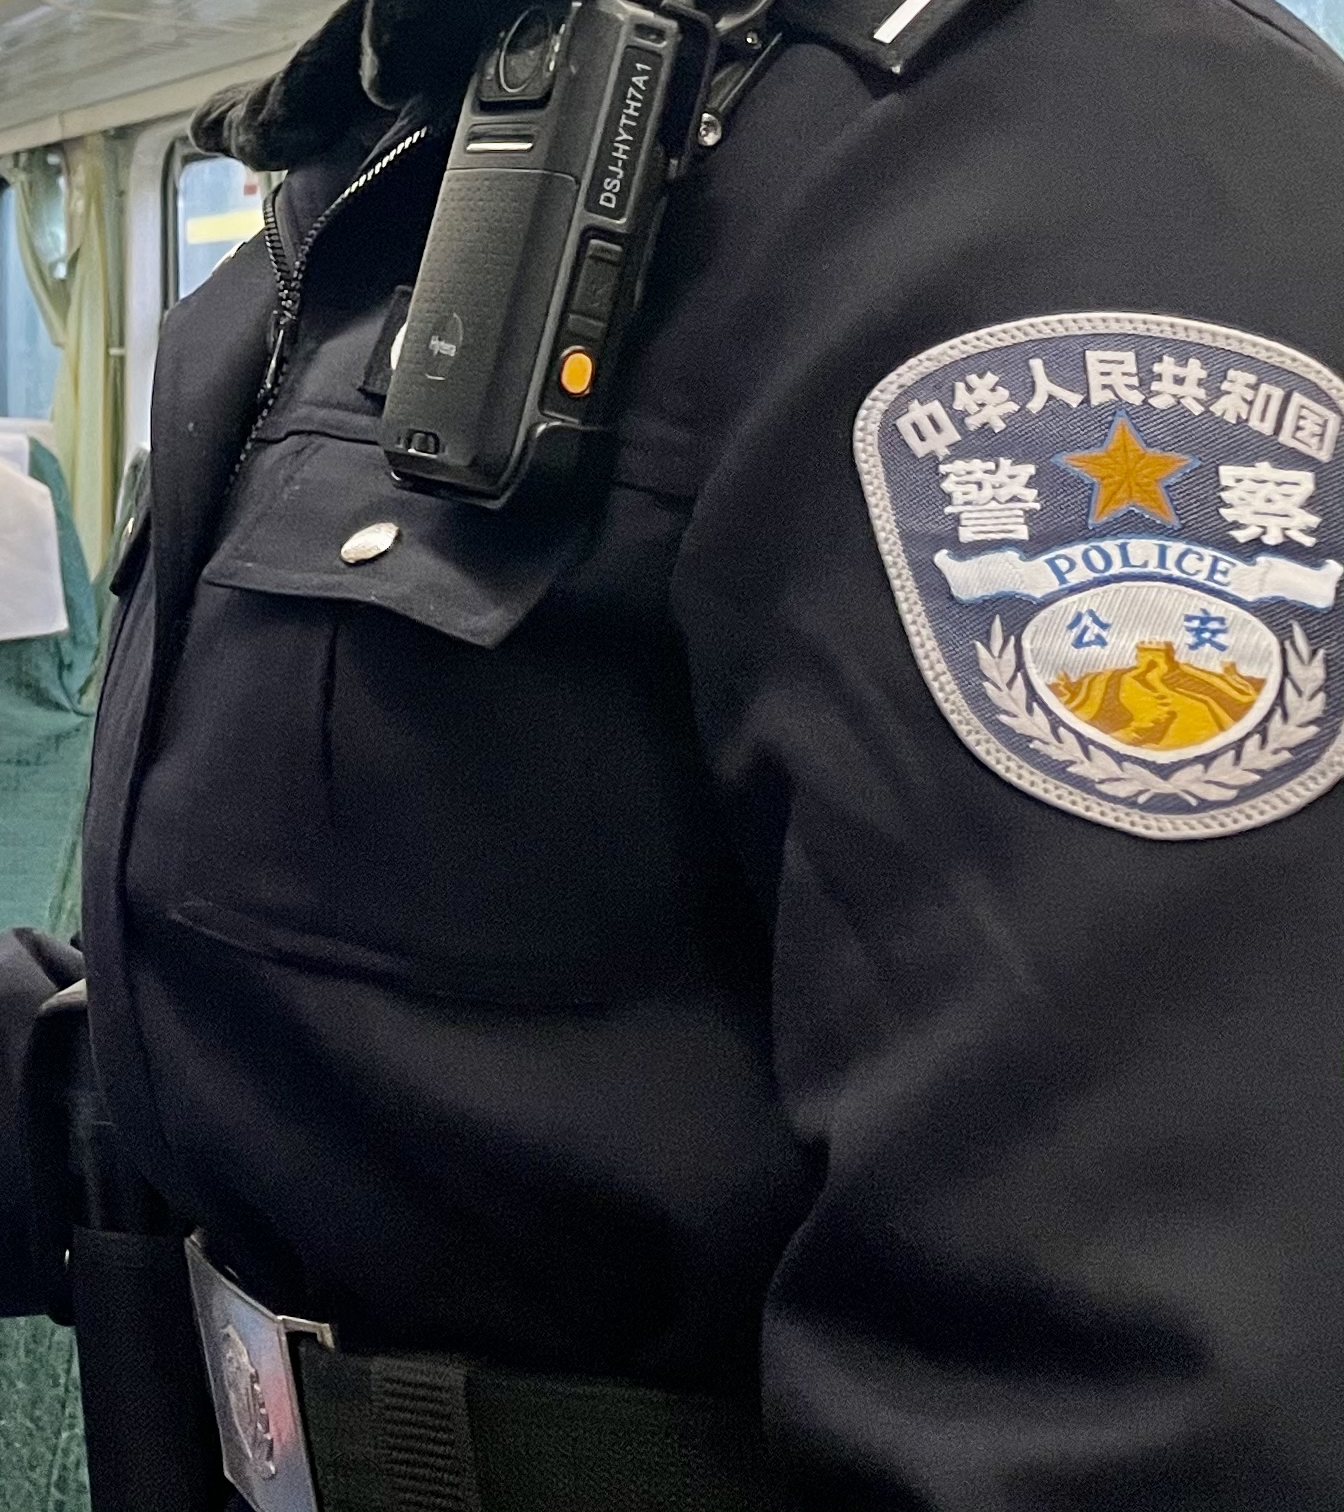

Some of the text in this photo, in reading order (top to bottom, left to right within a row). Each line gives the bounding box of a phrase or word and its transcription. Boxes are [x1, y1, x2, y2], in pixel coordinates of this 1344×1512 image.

[598, 61, 652, 210] DSJ-HYTH7A1
[895, 349, 1341, 462] 中华人民共和国
[1043, 541, 1237, 588] POLICE
